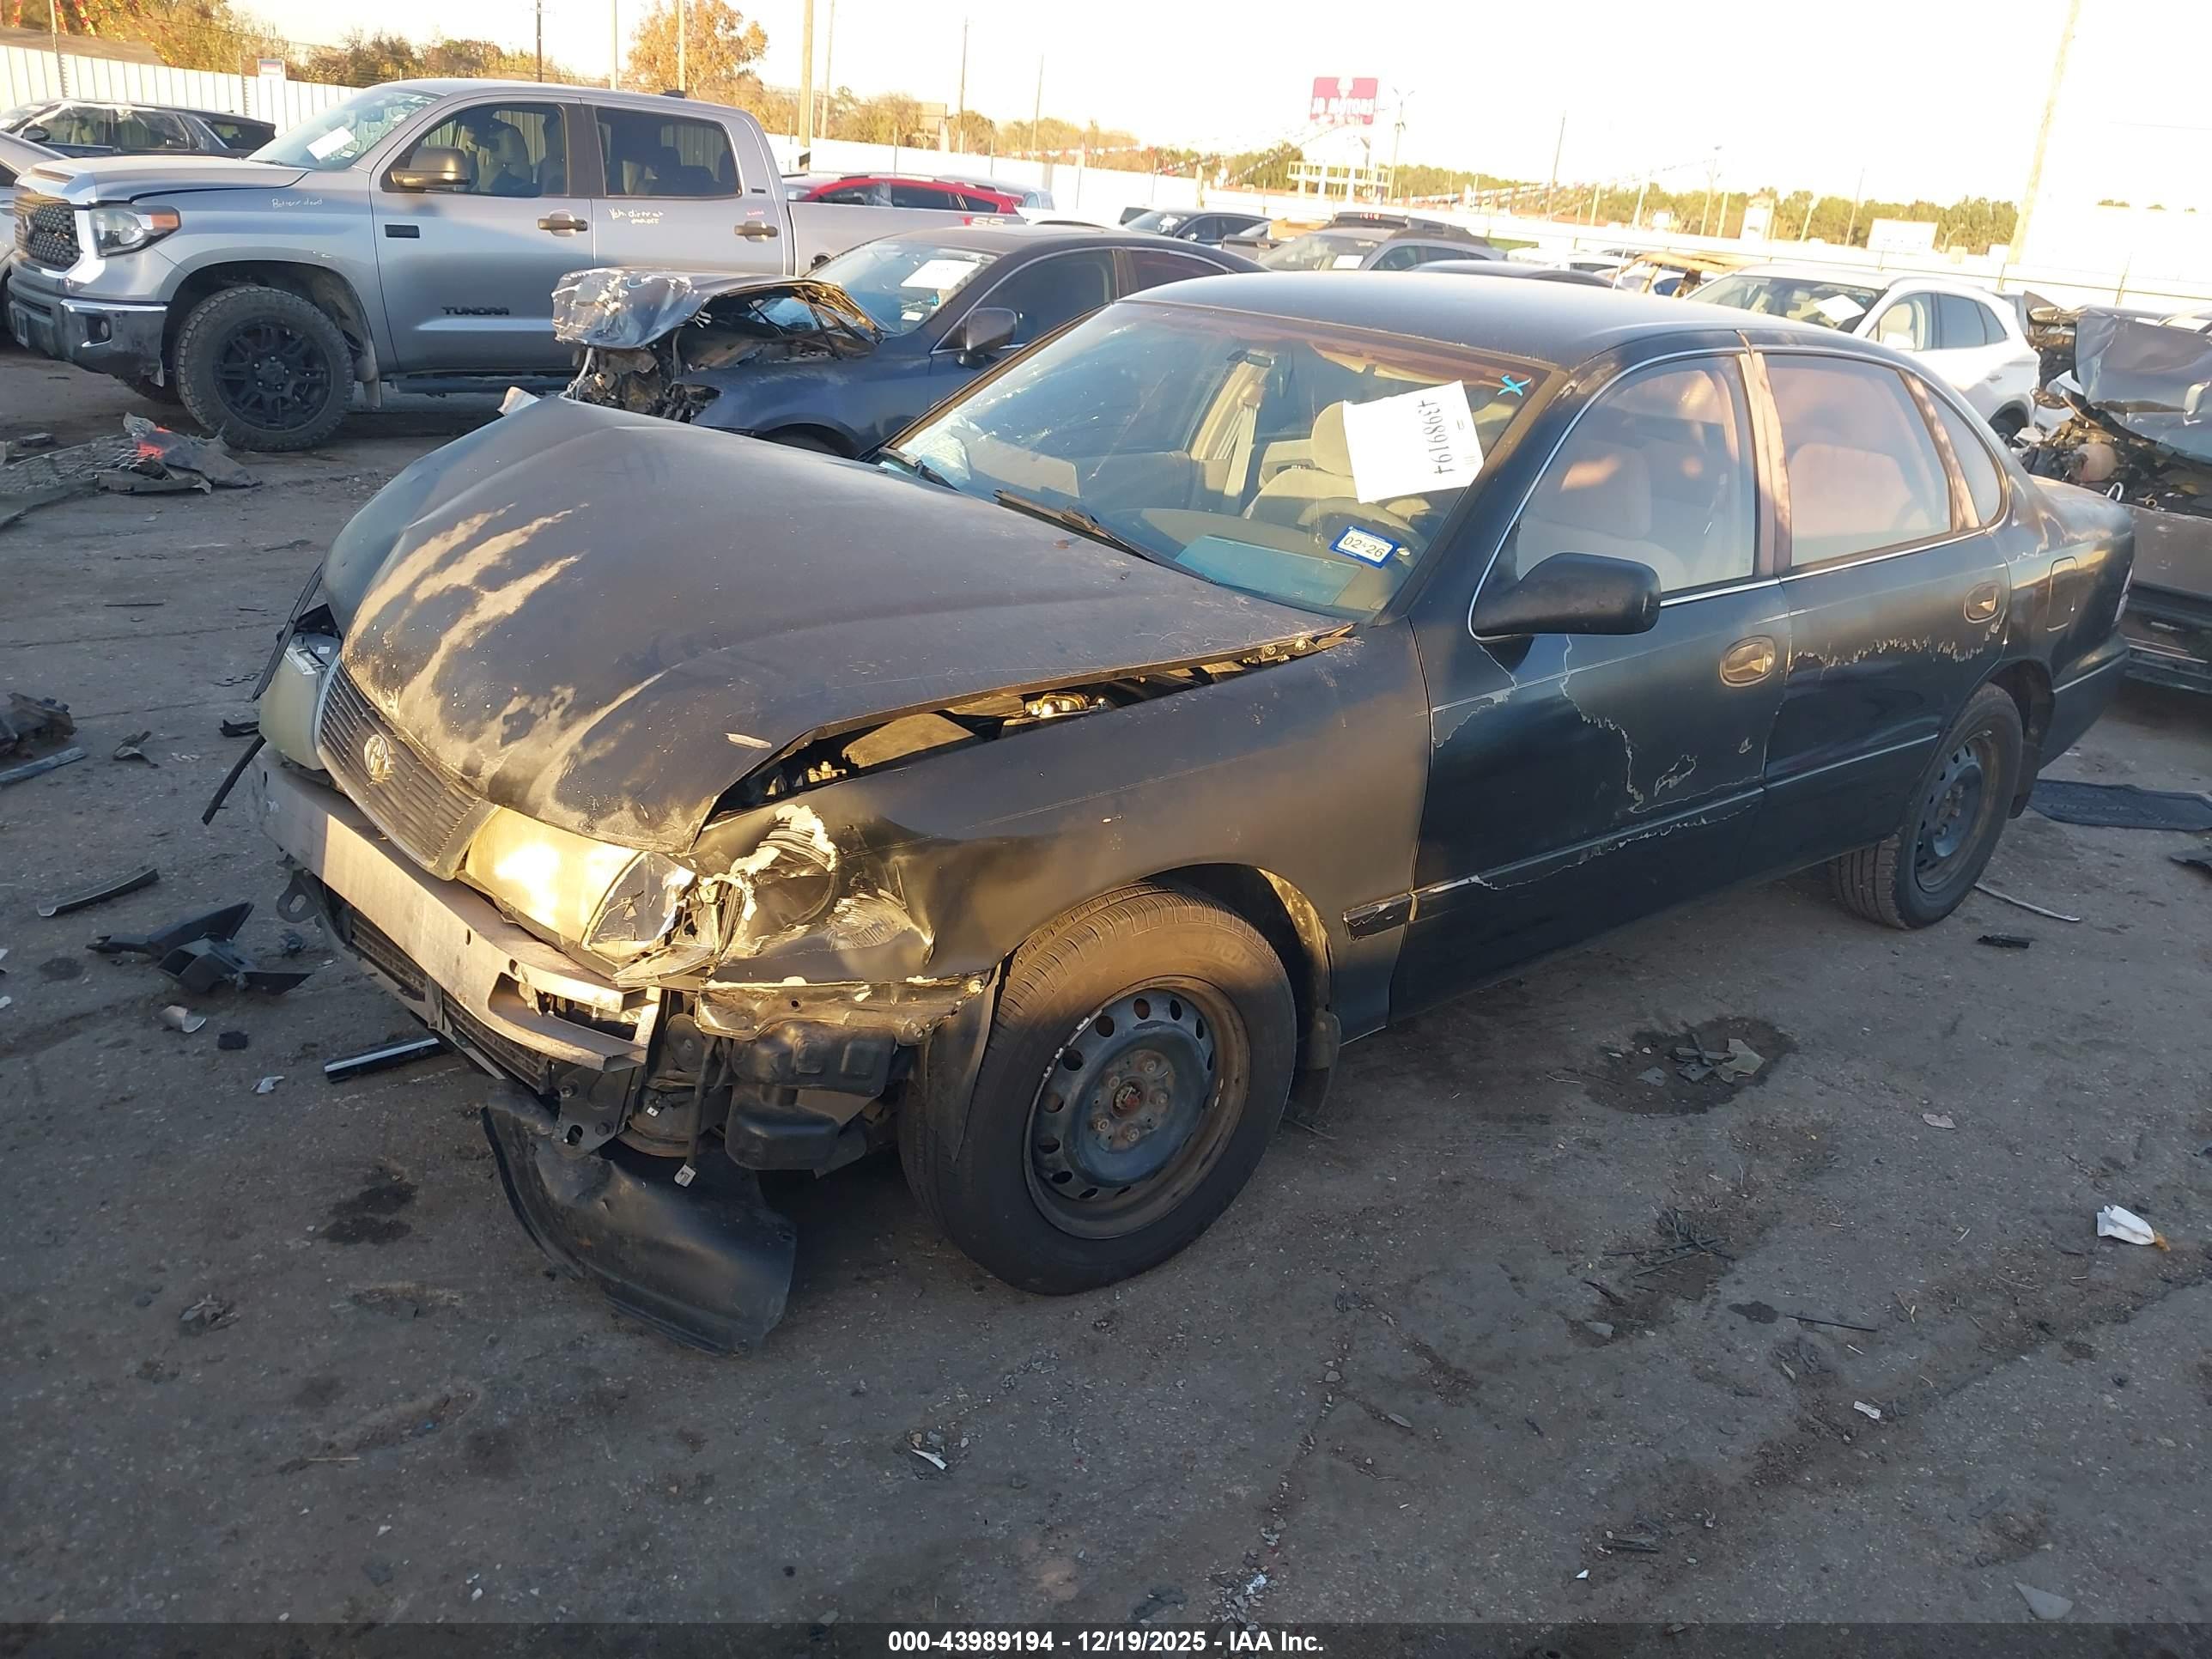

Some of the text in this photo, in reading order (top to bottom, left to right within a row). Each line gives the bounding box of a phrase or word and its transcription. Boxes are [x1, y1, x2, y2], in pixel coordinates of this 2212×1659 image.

[441, 307, 509, 316] TUNDRA
[1417, 399, 1456, 475] 43989194
[1343, 536, 1364, 550] 02
[1364, 544, 1387, 558] 26
